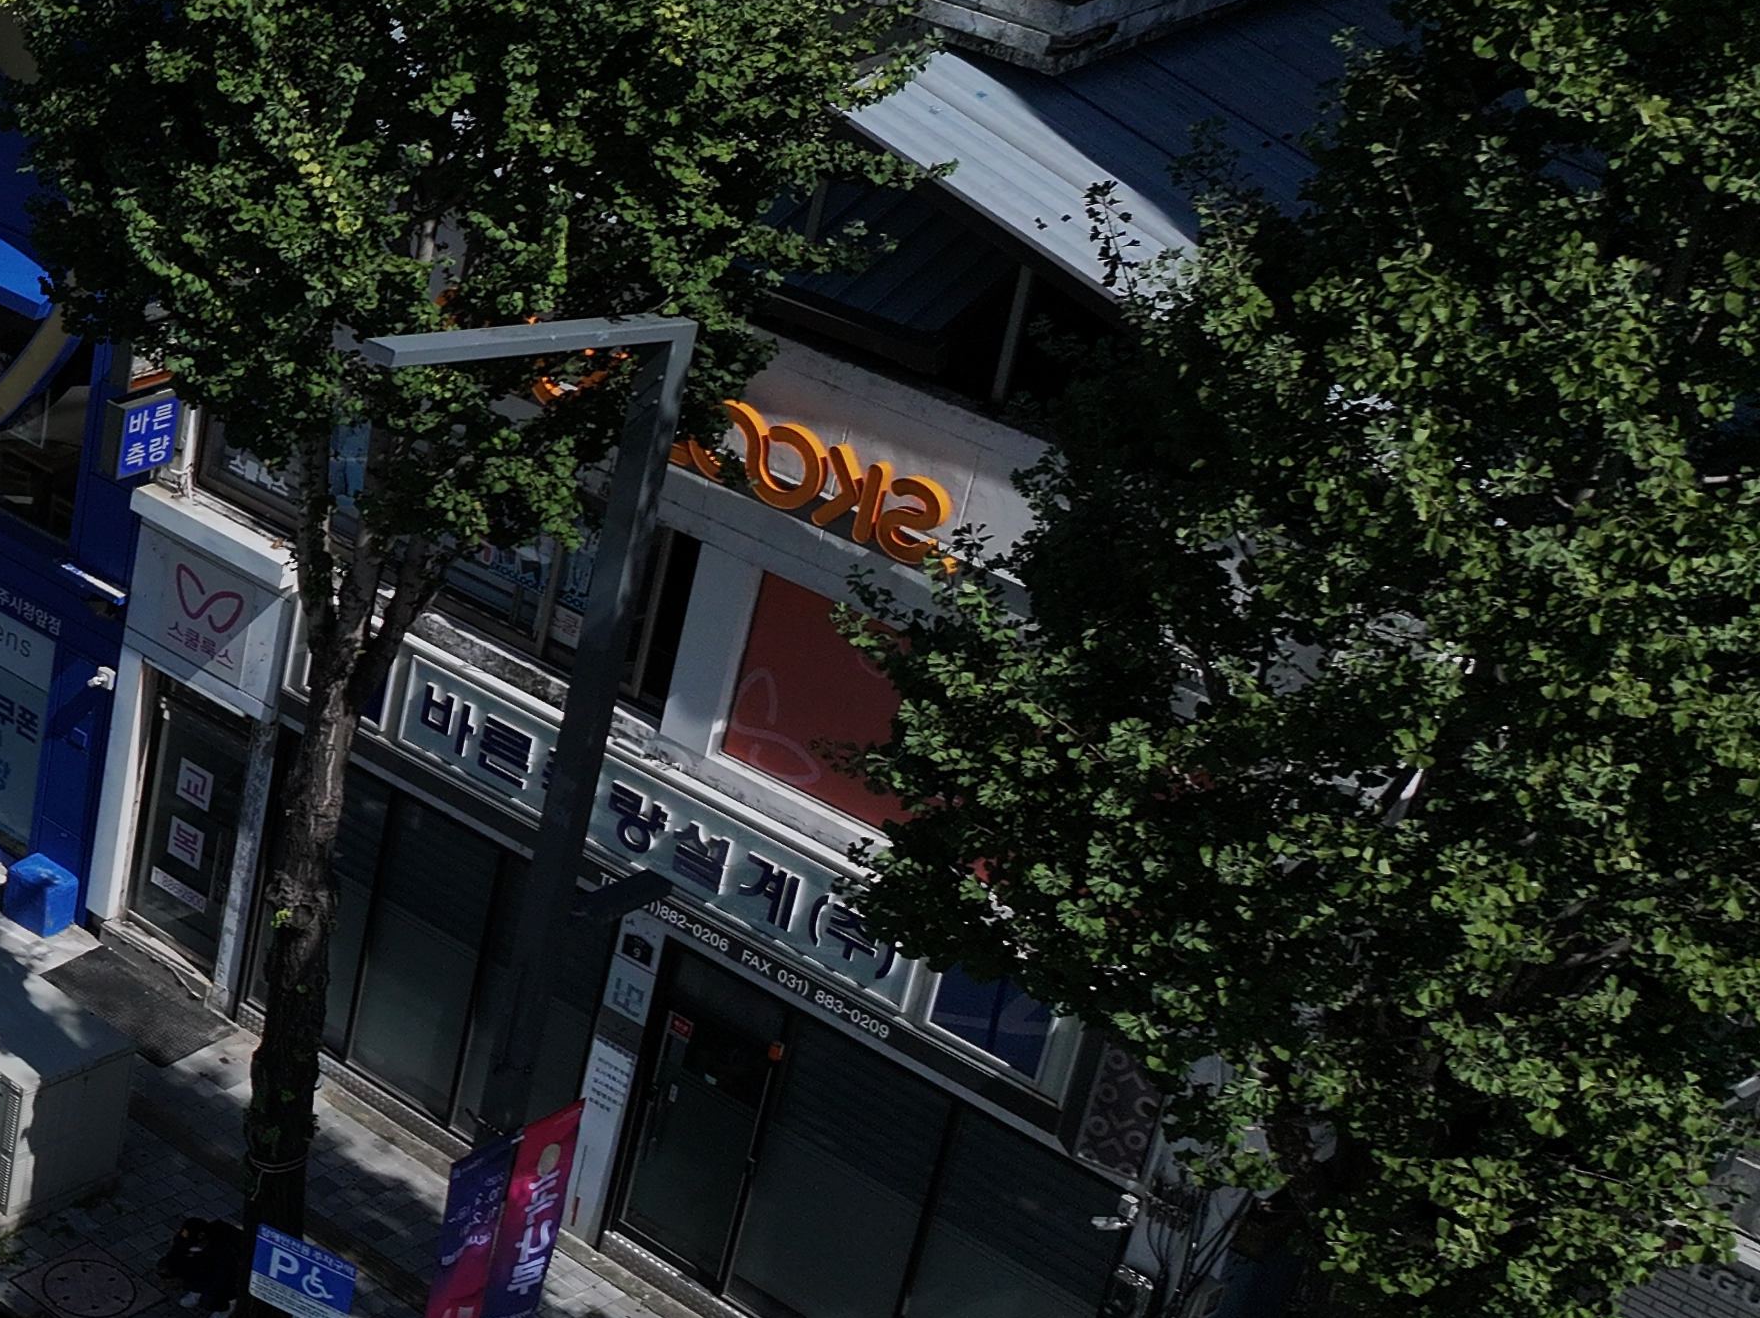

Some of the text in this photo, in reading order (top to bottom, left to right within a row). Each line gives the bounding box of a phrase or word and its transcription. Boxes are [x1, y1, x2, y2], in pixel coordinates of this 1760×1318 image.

[128, 402, 174, 435] 바른
[124, 434, 171, 467] 측량
[167, 620, 234, 671] 스쿨룩스
[181, 766, 208, 804] 교
[173, 823, 197, 863] 복
[642, 901, 730, 954] 1)882-0206
[740, 949, 773, 976] FAX
[777, 968, 811, 997] 031)
[814, 988, 891, 1041] 883-0209
[268, 1246, 300, 1280] P
